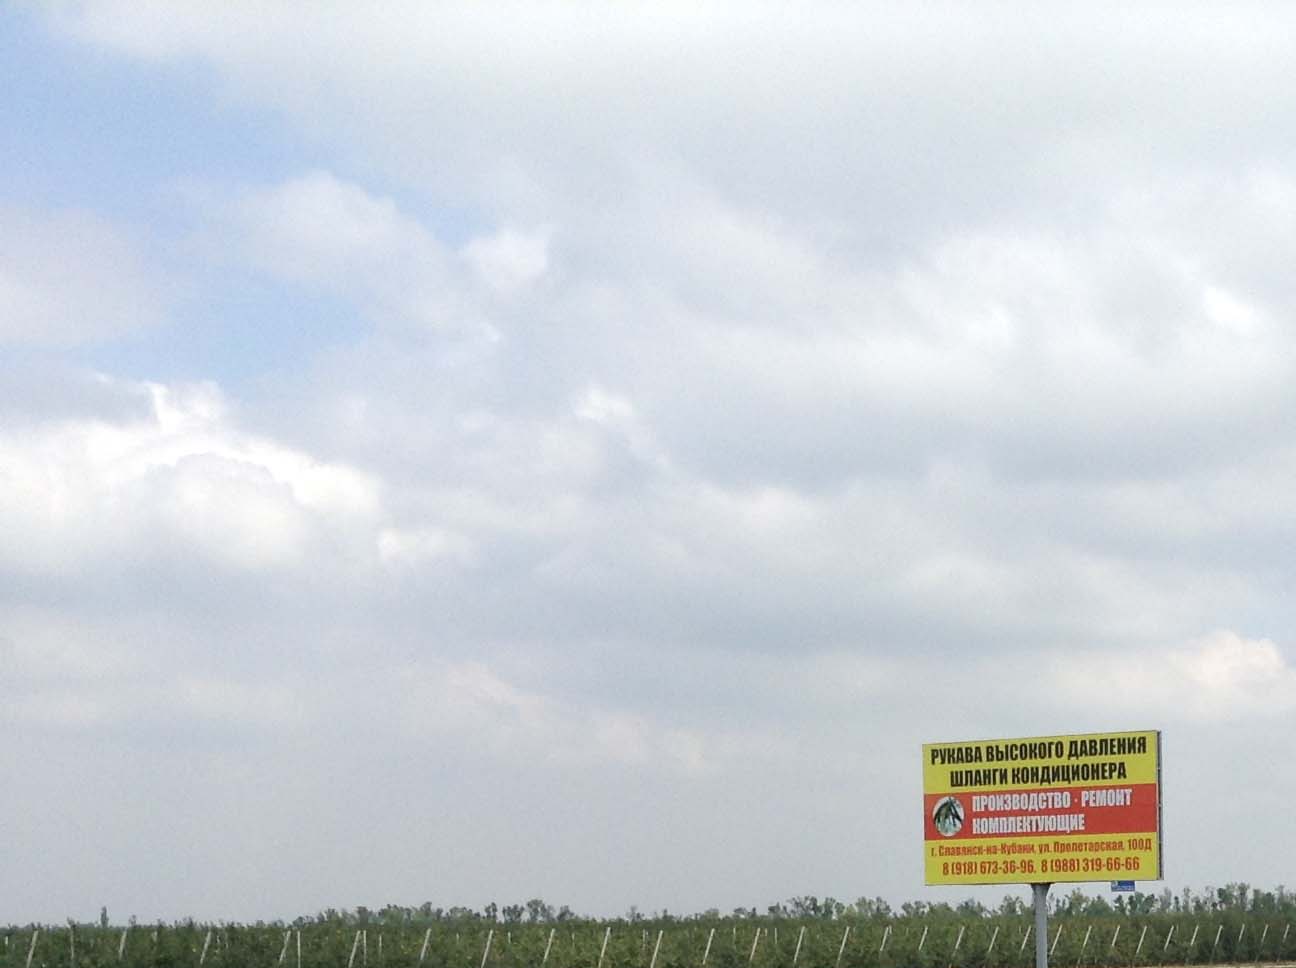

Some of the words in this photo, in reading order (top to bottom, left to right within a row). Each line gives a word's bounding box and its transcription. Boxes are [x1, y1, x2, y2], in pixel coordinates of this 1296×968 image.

[931, 746, 982, 765] РУКАВА
[986, 741, 1064, 762] ВЫСОКОГО
[1067, 736, 1147, 760] ДАВЛЕНИЯ
[950, 767, 1009, 788] ШЛАНГИ
[1012, 762, 1127, 787] КОНДИЦИОНЕРА
[972, 791, 1071, 812] ПРОИЗВОДСТВО
[1081, 788, 1133, 807] РЕМОНТ
[972, 813, 1086, 835] КОМПЛЕКТУЮЩИЕ
[942, 862, 950, 875] 8
[951, 861, 977, 876] (918)
[1041, 860, 1048, 873] 8
[1082, 857, 1140, 872] 319-66-66
